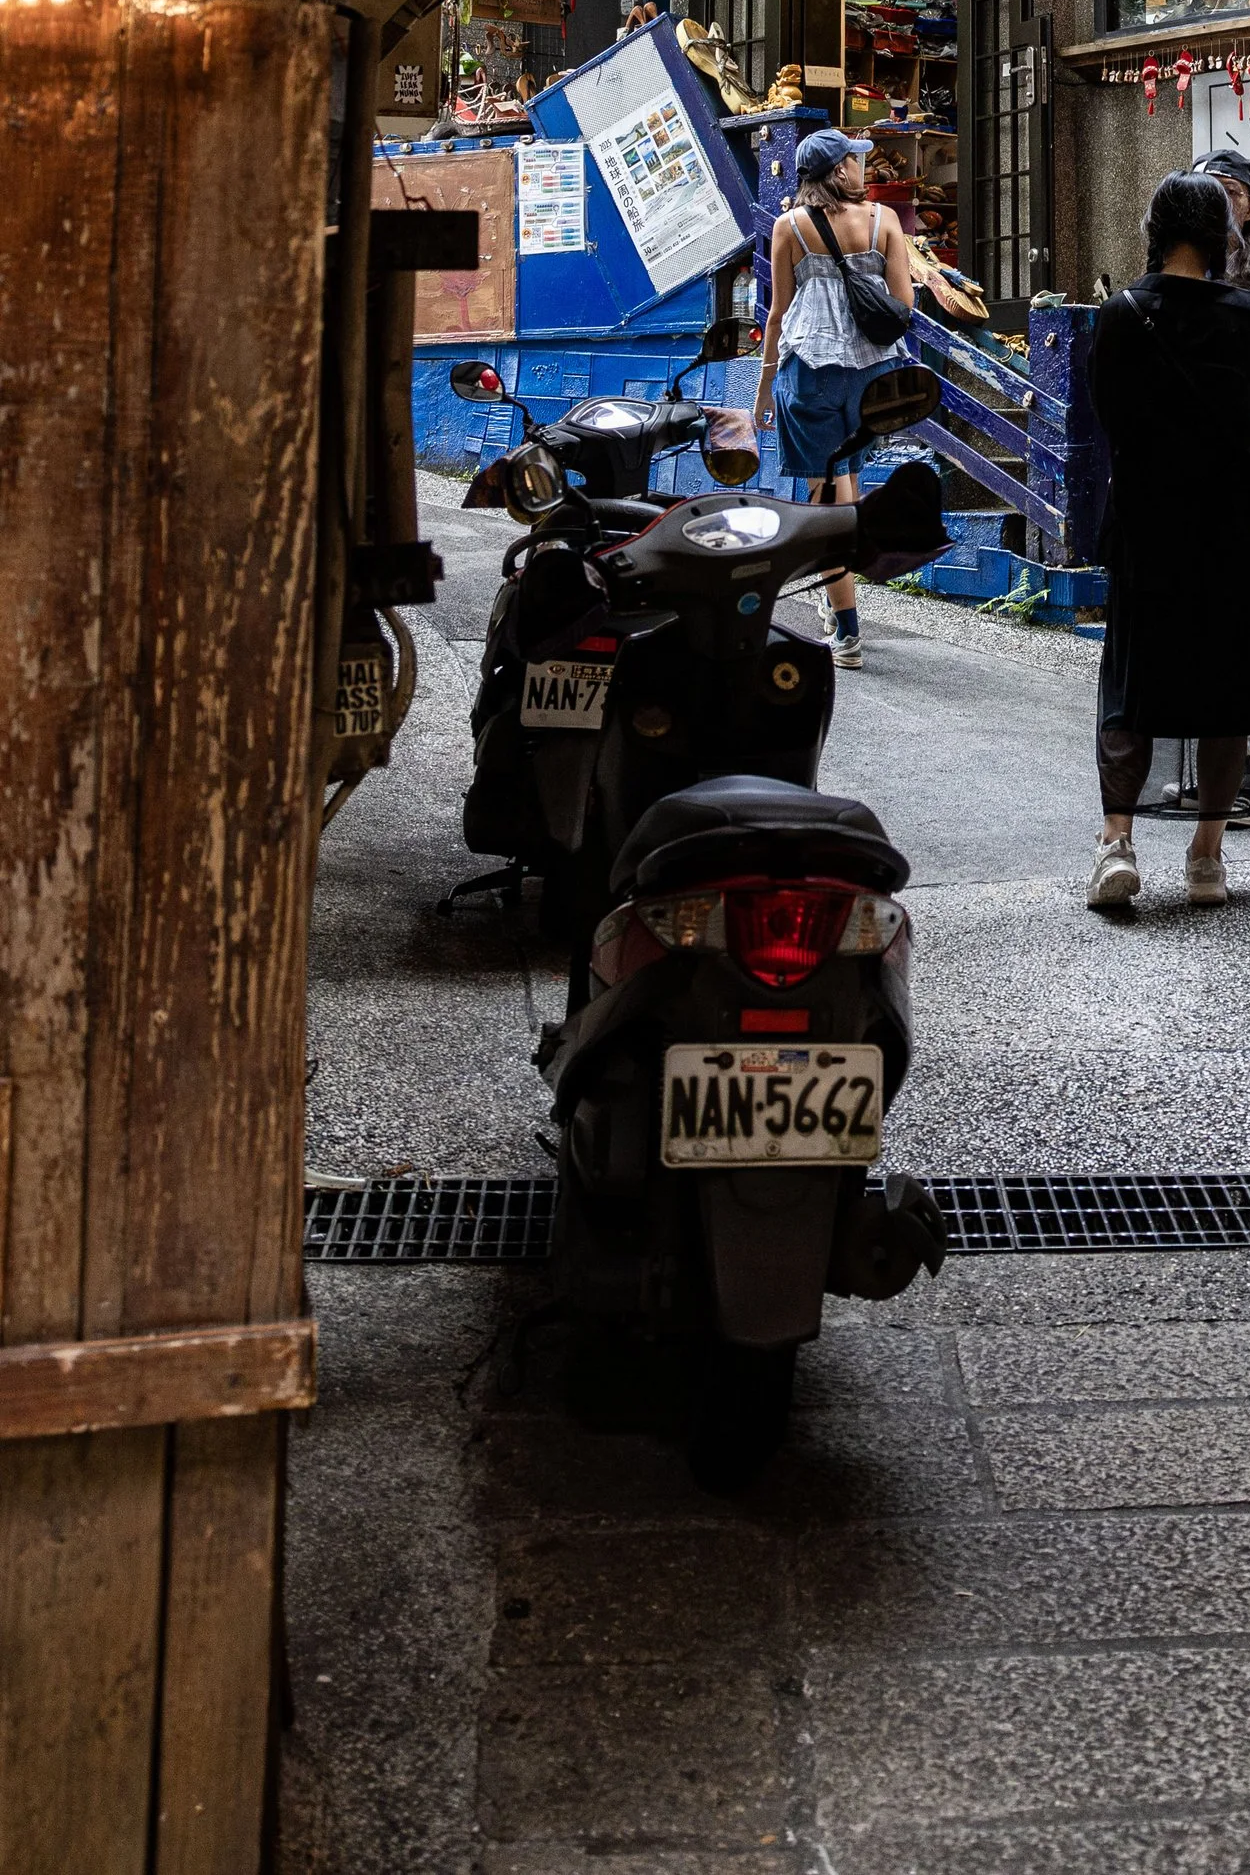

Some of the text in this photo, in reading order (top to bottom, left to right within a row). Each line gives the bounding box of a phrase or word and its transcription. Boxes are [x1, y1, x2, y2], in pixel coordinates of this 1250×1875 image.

[604, 155, 645, 234] 地球一周の船旅
